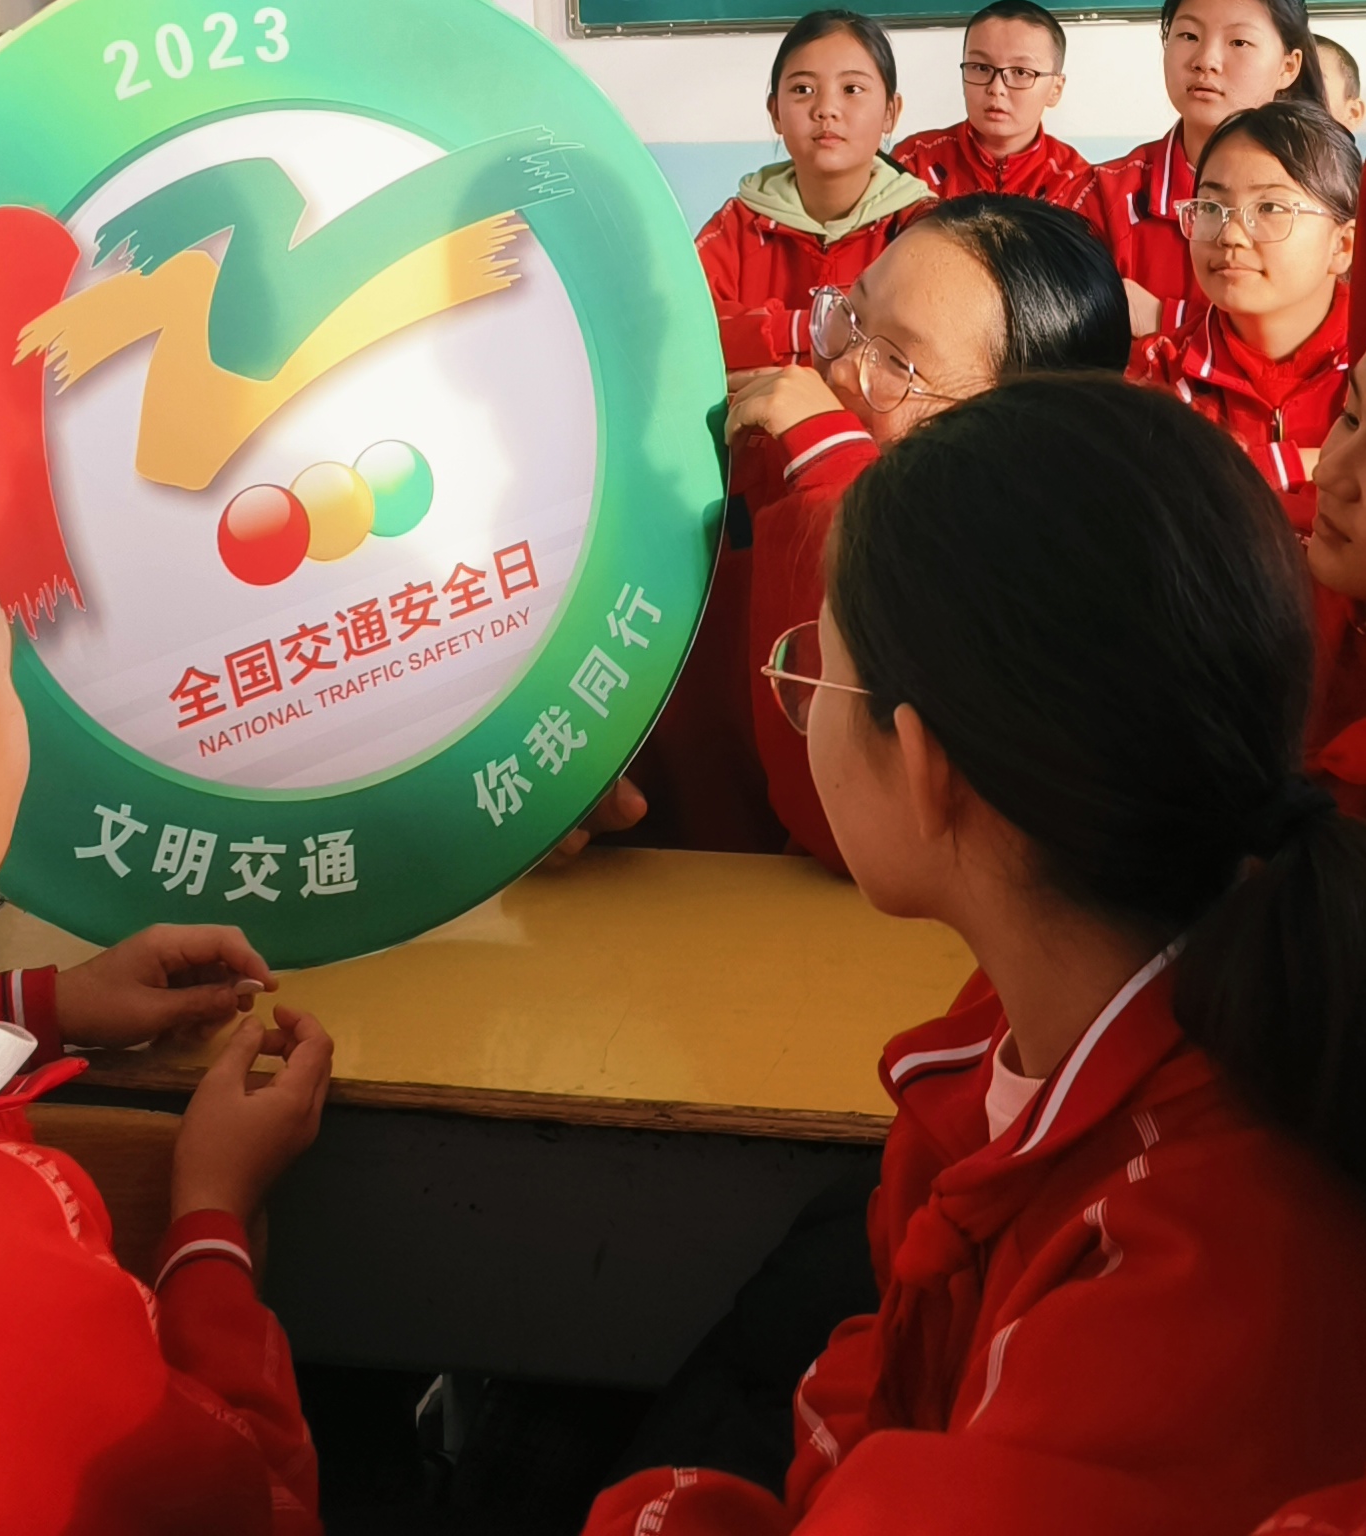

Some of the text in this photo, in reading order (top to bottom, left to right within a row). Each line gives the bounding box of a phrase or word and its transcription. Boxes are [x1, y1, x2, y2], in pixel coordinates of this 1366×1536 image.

[103, 6, 293, 101] 2023
[168, 539, 540, 729] 全国交通安全日
[197, 607, 532, 758] NATIONAL TRAFFIC SAFETY DAY
[75, 580, 664, 903] 文明交通 你我同行
